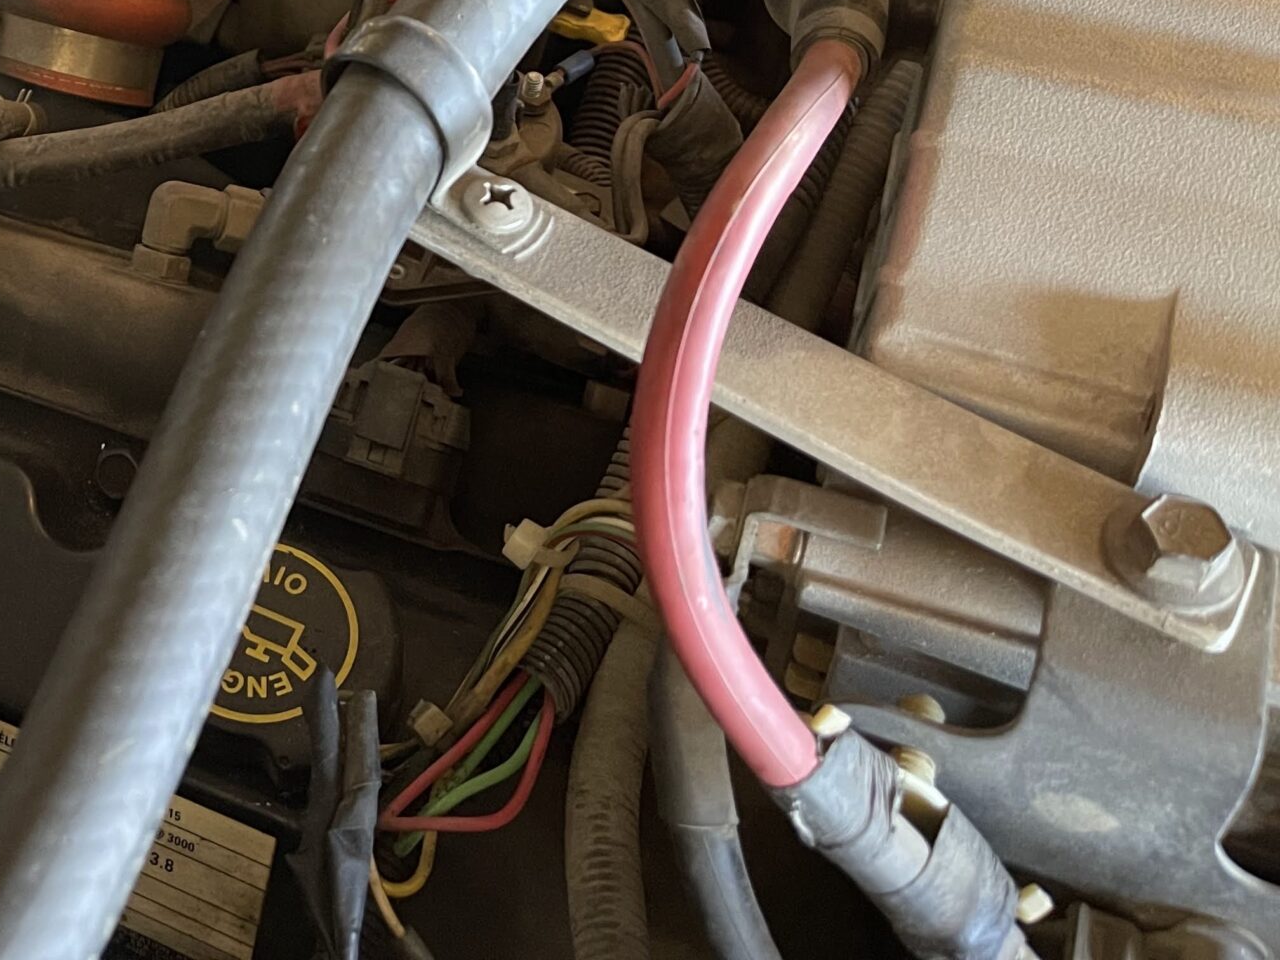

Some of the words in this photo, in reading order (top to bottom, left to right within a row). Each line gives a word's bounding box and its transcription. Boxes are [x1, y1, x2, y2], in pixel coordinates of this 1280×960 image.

[222, 668, 293, 698] ENG
[167, 833, 195, 852] 3000
[149, 851, 174, 873] 3.8
